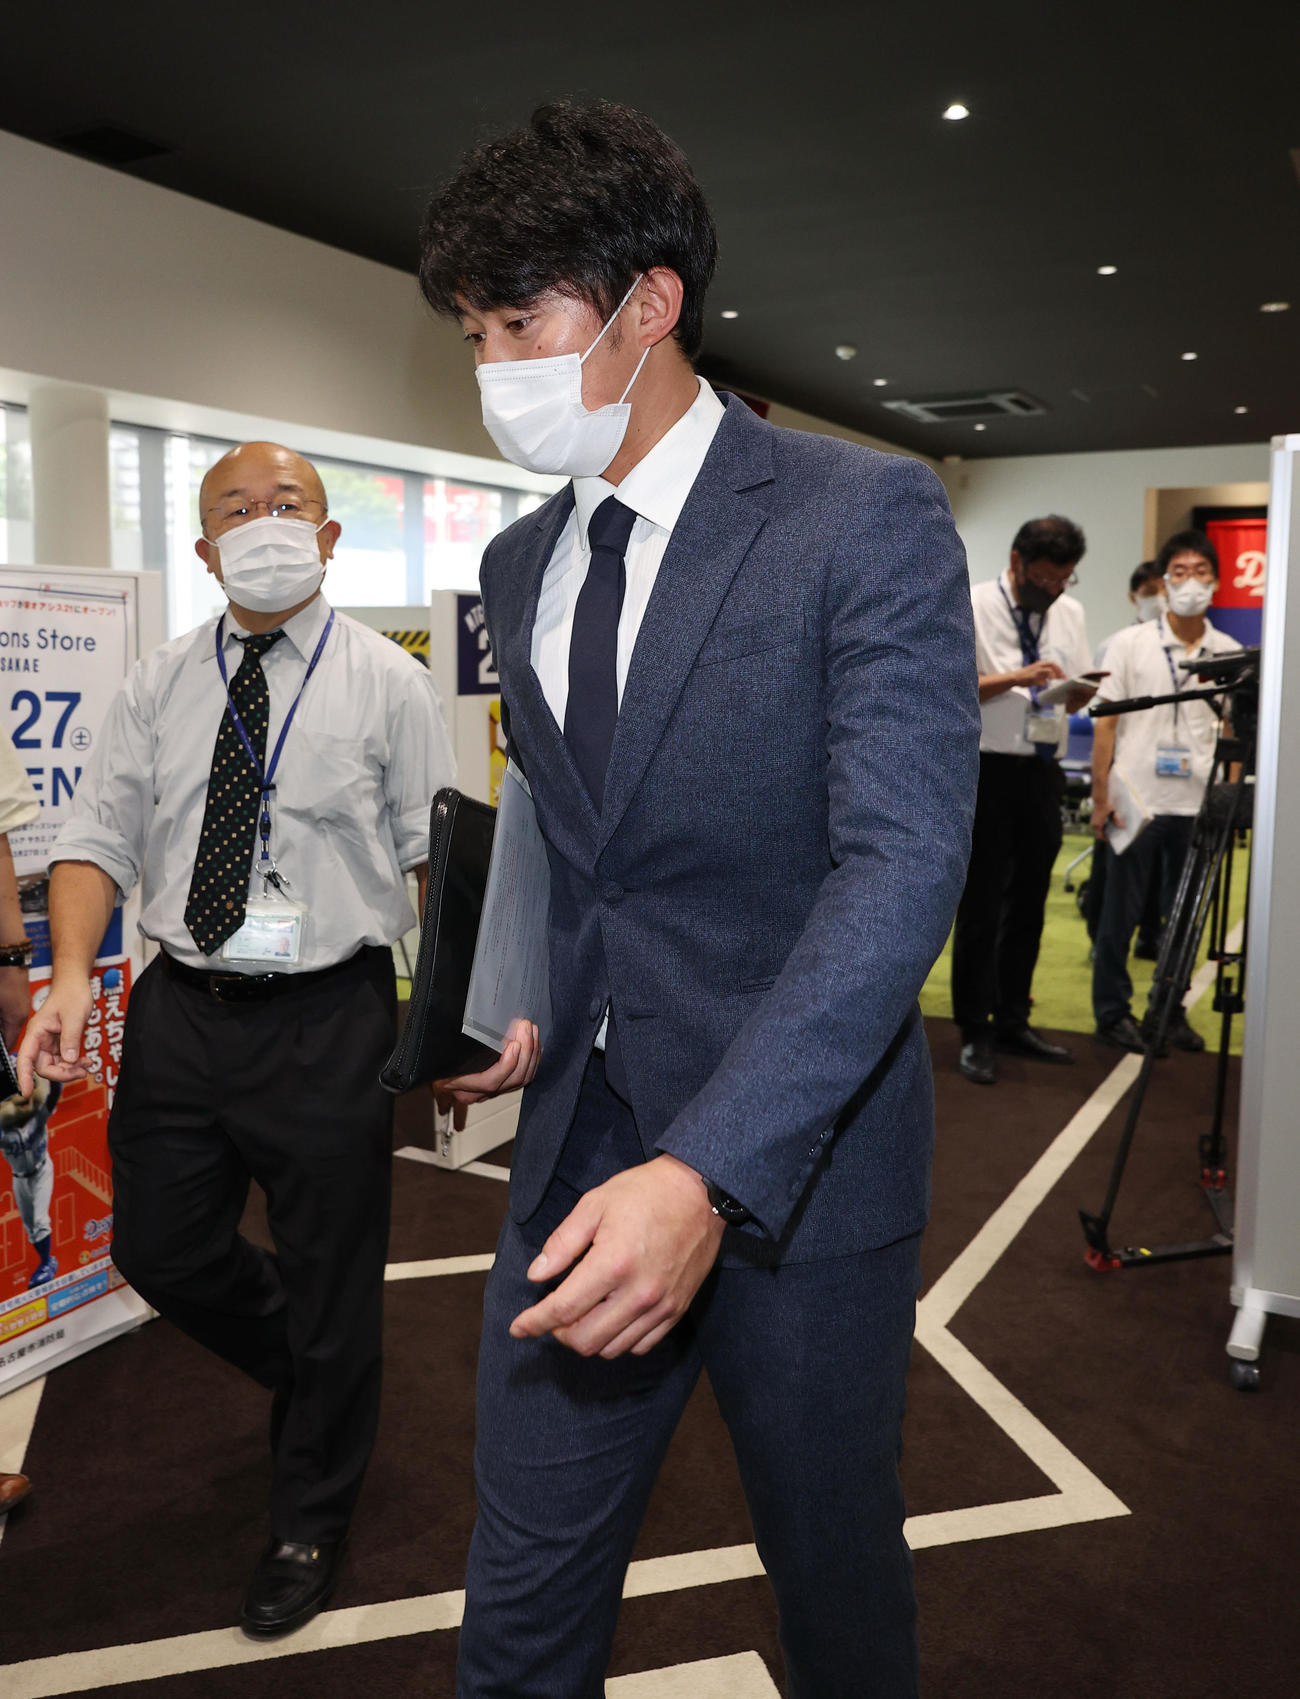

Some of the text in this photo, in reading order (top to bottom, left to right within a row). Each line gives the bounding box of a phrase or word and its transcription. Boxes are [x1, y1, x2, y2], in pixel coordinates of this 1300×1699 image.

[37, 628, 96, 652] Store
[0, 657, 39, 673] SAKAE
[11, 690, 90, 749] 27 土
